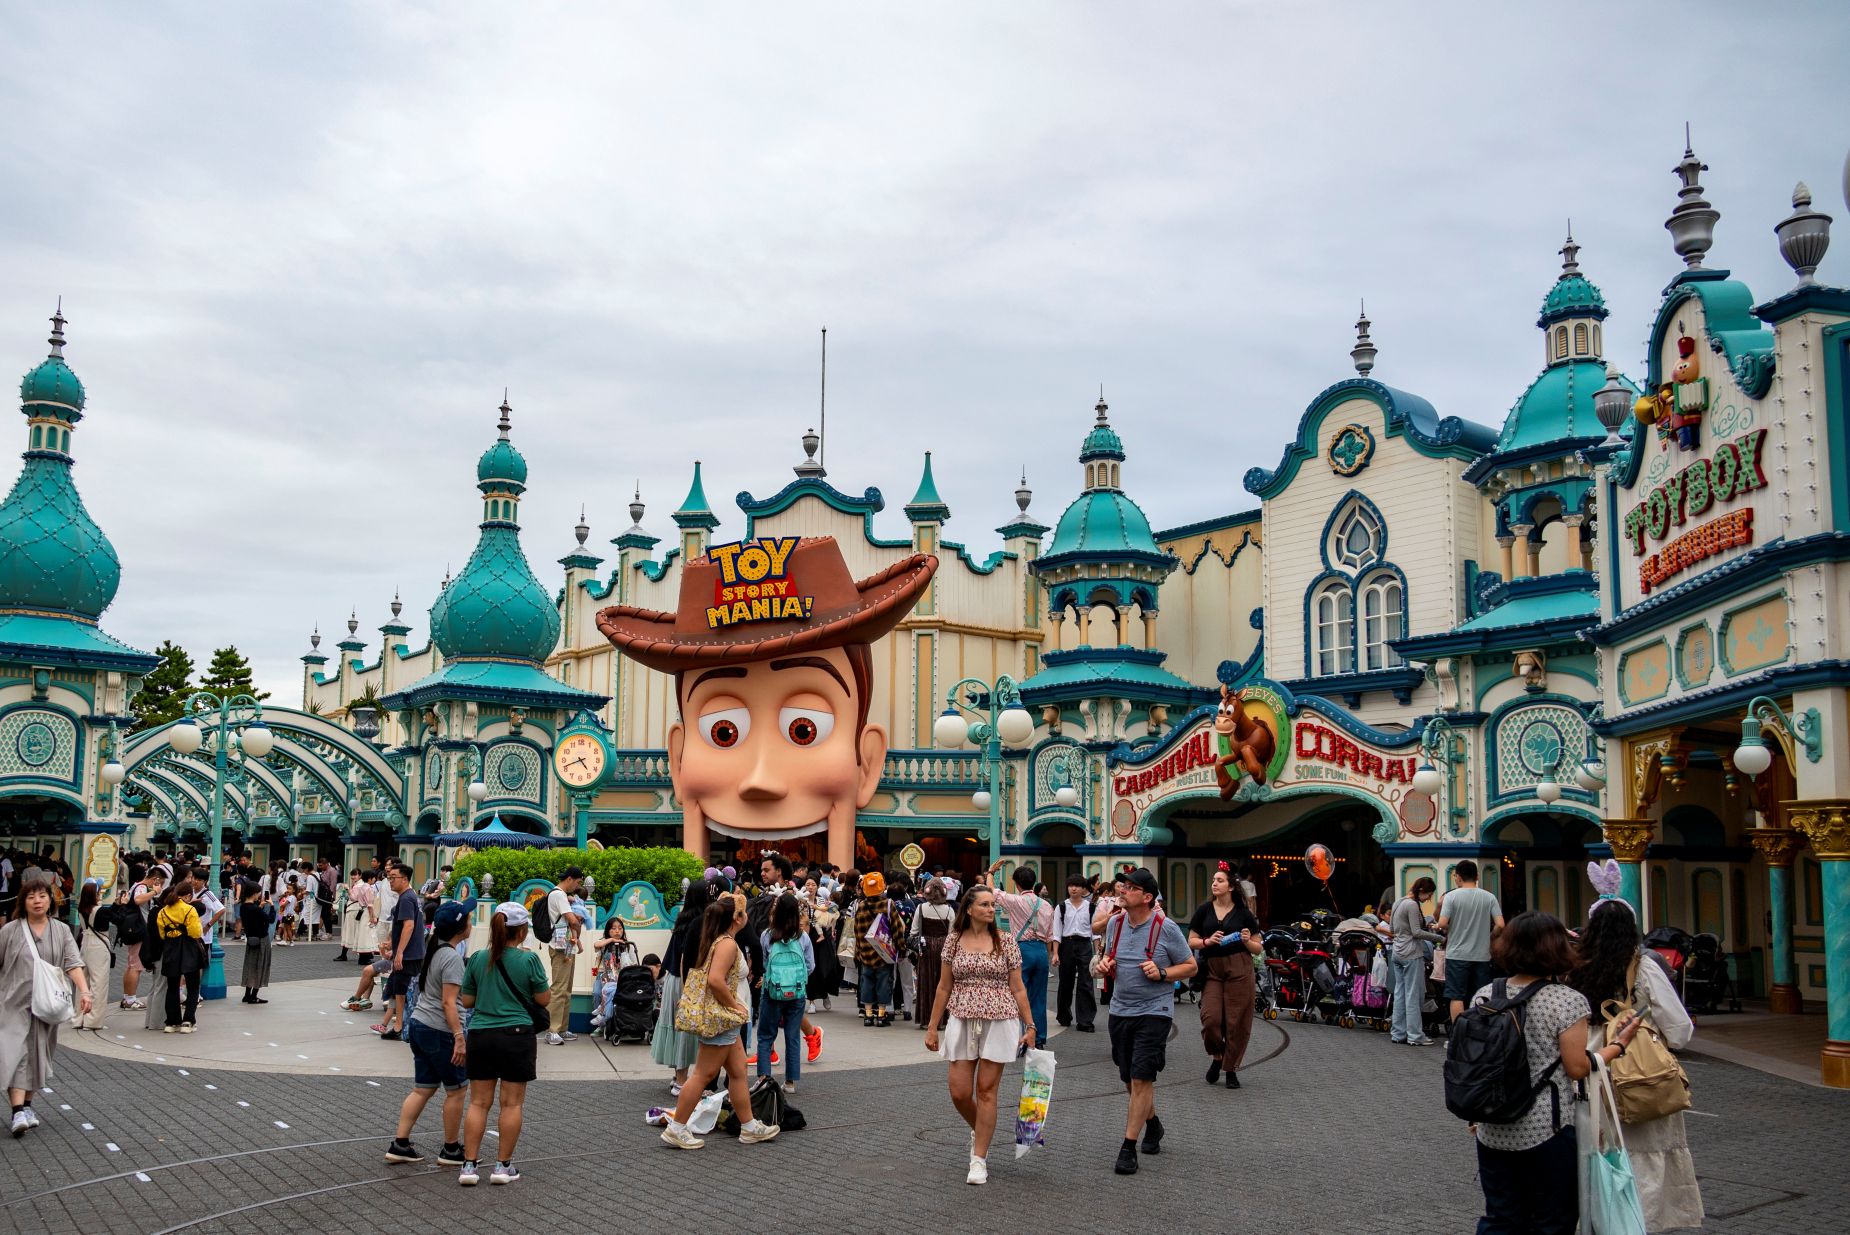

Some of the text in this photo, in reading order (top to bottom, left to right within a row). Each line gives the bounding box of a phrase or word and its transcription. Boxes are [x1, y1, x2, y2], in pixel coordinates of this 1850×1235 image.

[1625, 428, 1768, 556] TOYBOX
[707, 537, 800, 585] TOY
[721, 581, 789, 601] STORY
[705, 596, 814, 629] MANIA!
[1114, 731, 1217, 797] CARNIVAL
[1176, 769, 1209, 787] RUSTLE
[1295, 764, 1323, 780] SOME
